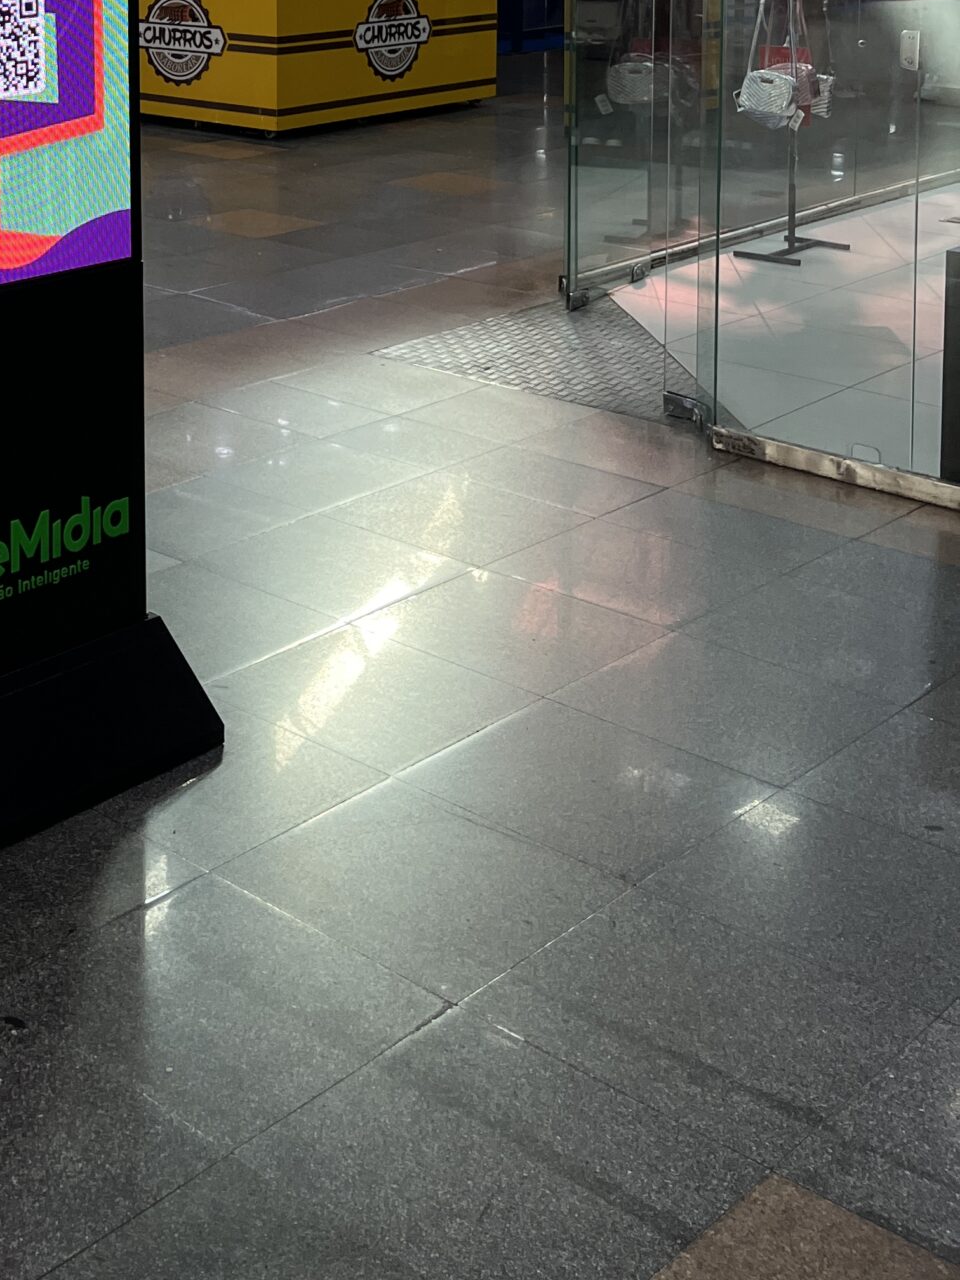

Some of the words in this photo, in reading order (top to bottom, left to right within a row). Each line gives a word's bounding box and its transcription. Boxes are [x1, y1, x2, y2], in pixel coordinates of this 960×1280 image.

[143, 26, 213, 50] CHURROS
[363, 20, 422, 45] CHURROS
[17, 559, 90, 594] Inteligente
